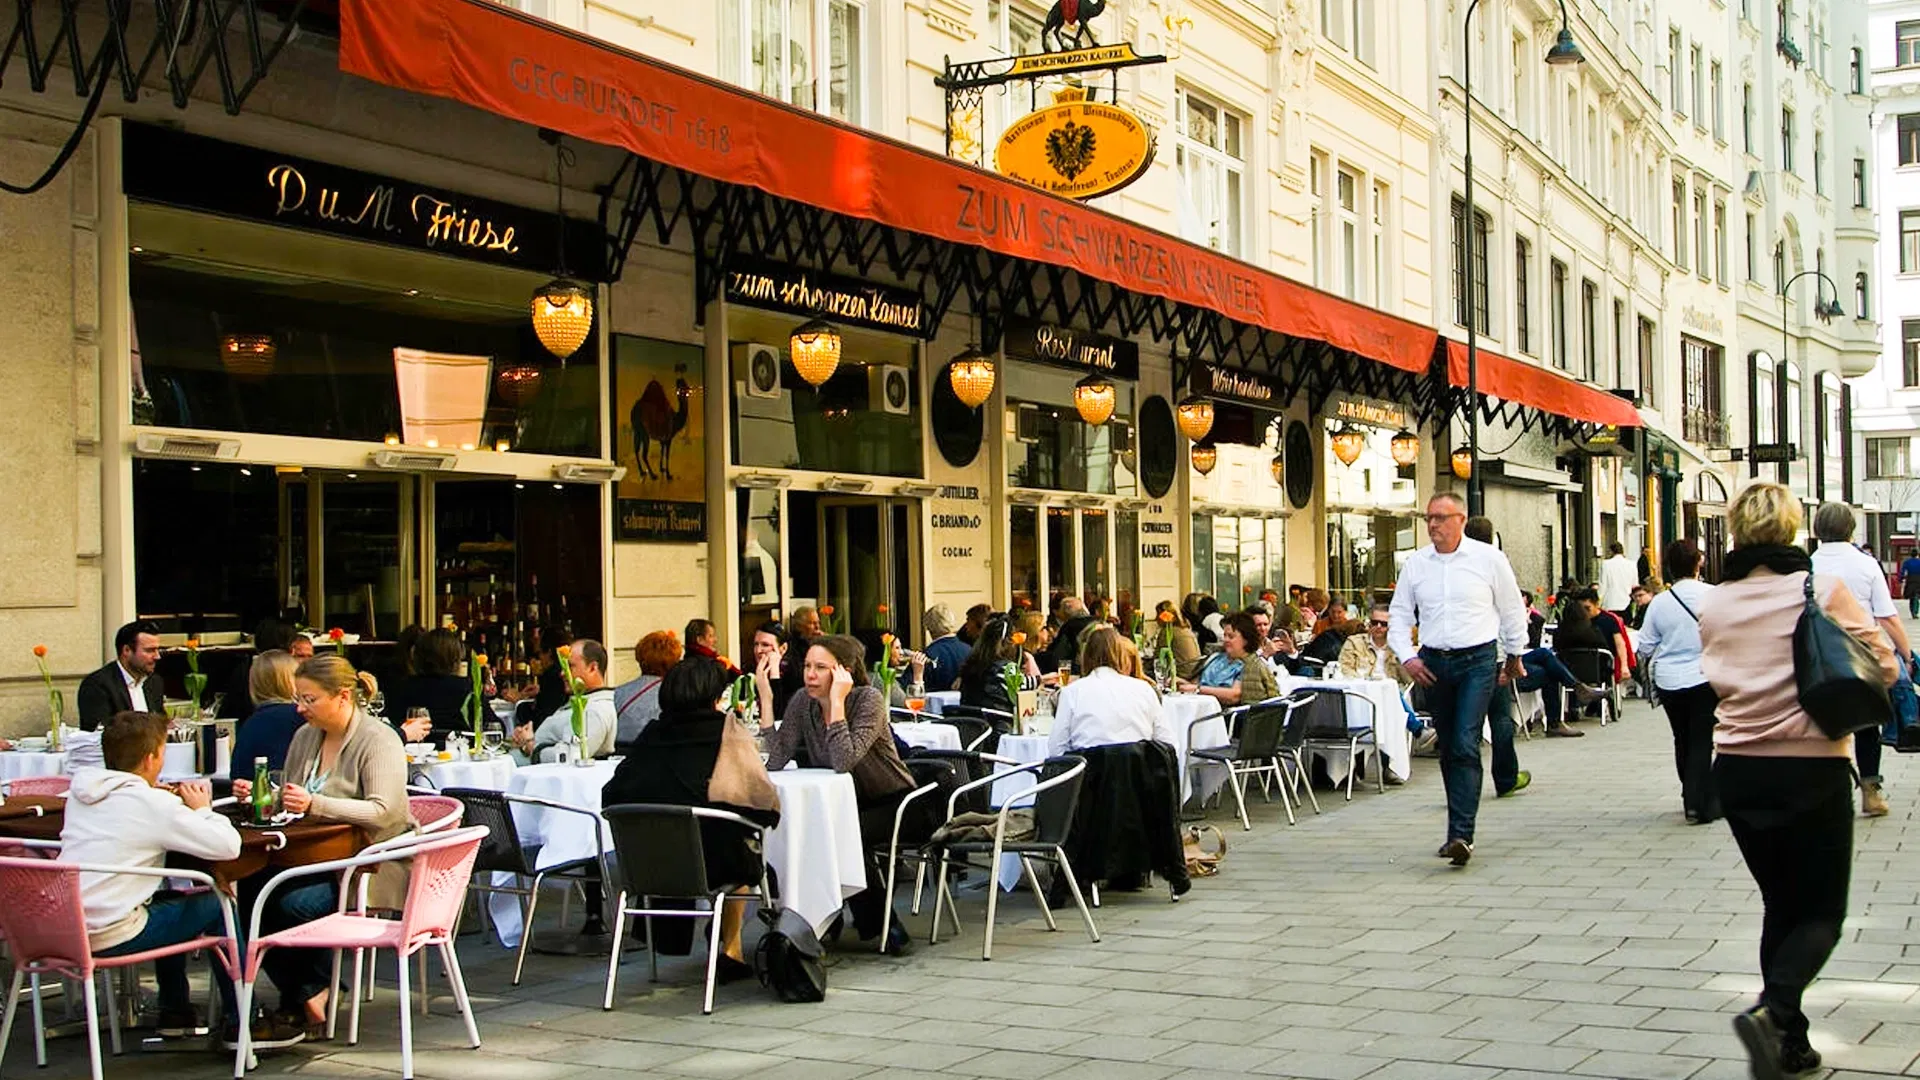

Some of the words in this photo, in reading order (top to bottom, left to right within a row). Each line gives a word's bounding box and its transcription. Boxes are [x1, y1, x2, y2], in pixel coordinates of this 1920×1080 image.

[684, 117, 731, 154] 1618
[411, 193, 519, 254] Friese
[956, 184, 1028, 243] ZUM
[1038, 207, 1188, 292] SCHWARZEN
[942, 546, 973, 557] COGNAC
